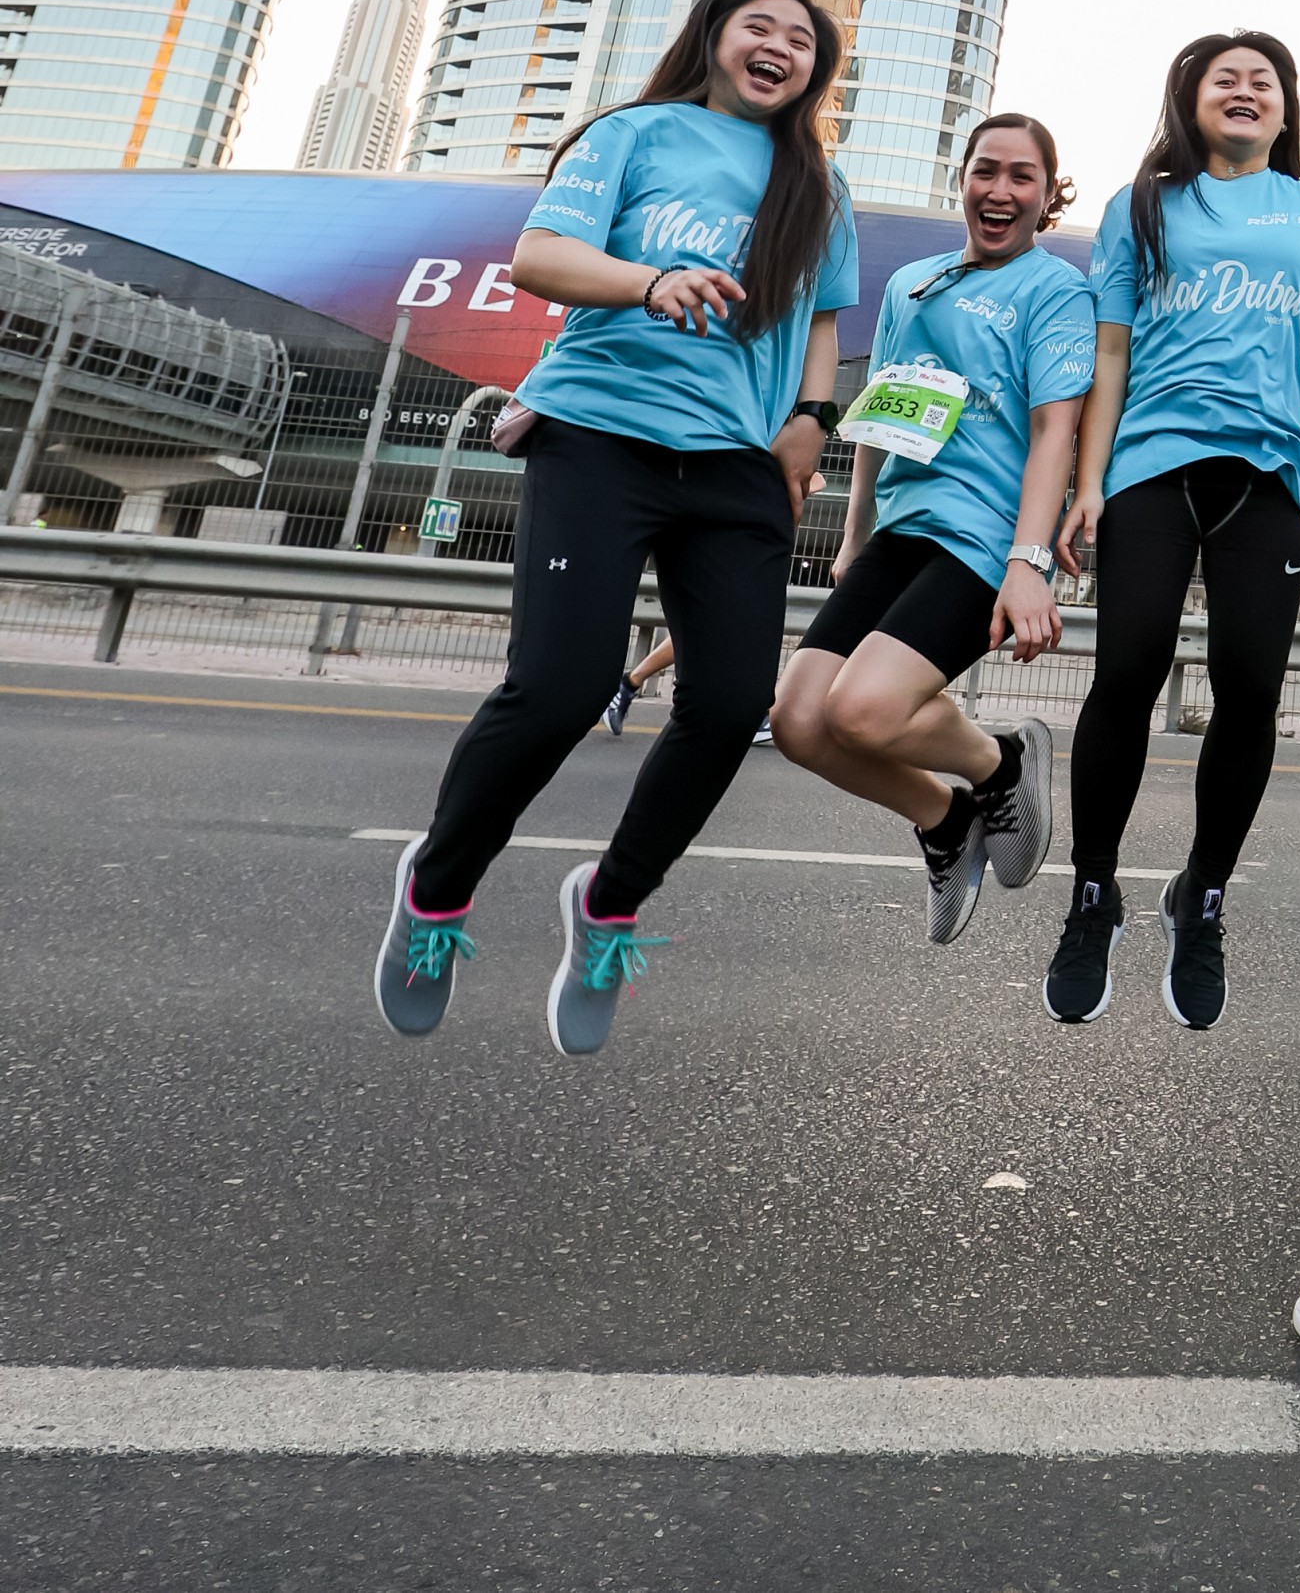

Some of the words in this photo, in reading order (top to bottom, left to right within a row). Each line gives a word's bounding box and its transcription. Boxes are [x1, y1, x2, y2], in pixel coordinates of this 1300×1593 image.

[549, 204, 596, 226] WORLD
[1247, 216, 1289, 225] RUN
[641, 200, 726, 256] Mai
[40, 242, 88, 257] FOR
[396, 258, 565, 317] BE
[954, 297, 997, 319] RUN
[975, 295, 1003, 311] DUBAI
[931, 399, 950, 408] 10KM
[400, 410, 478, 428] BEYOD
